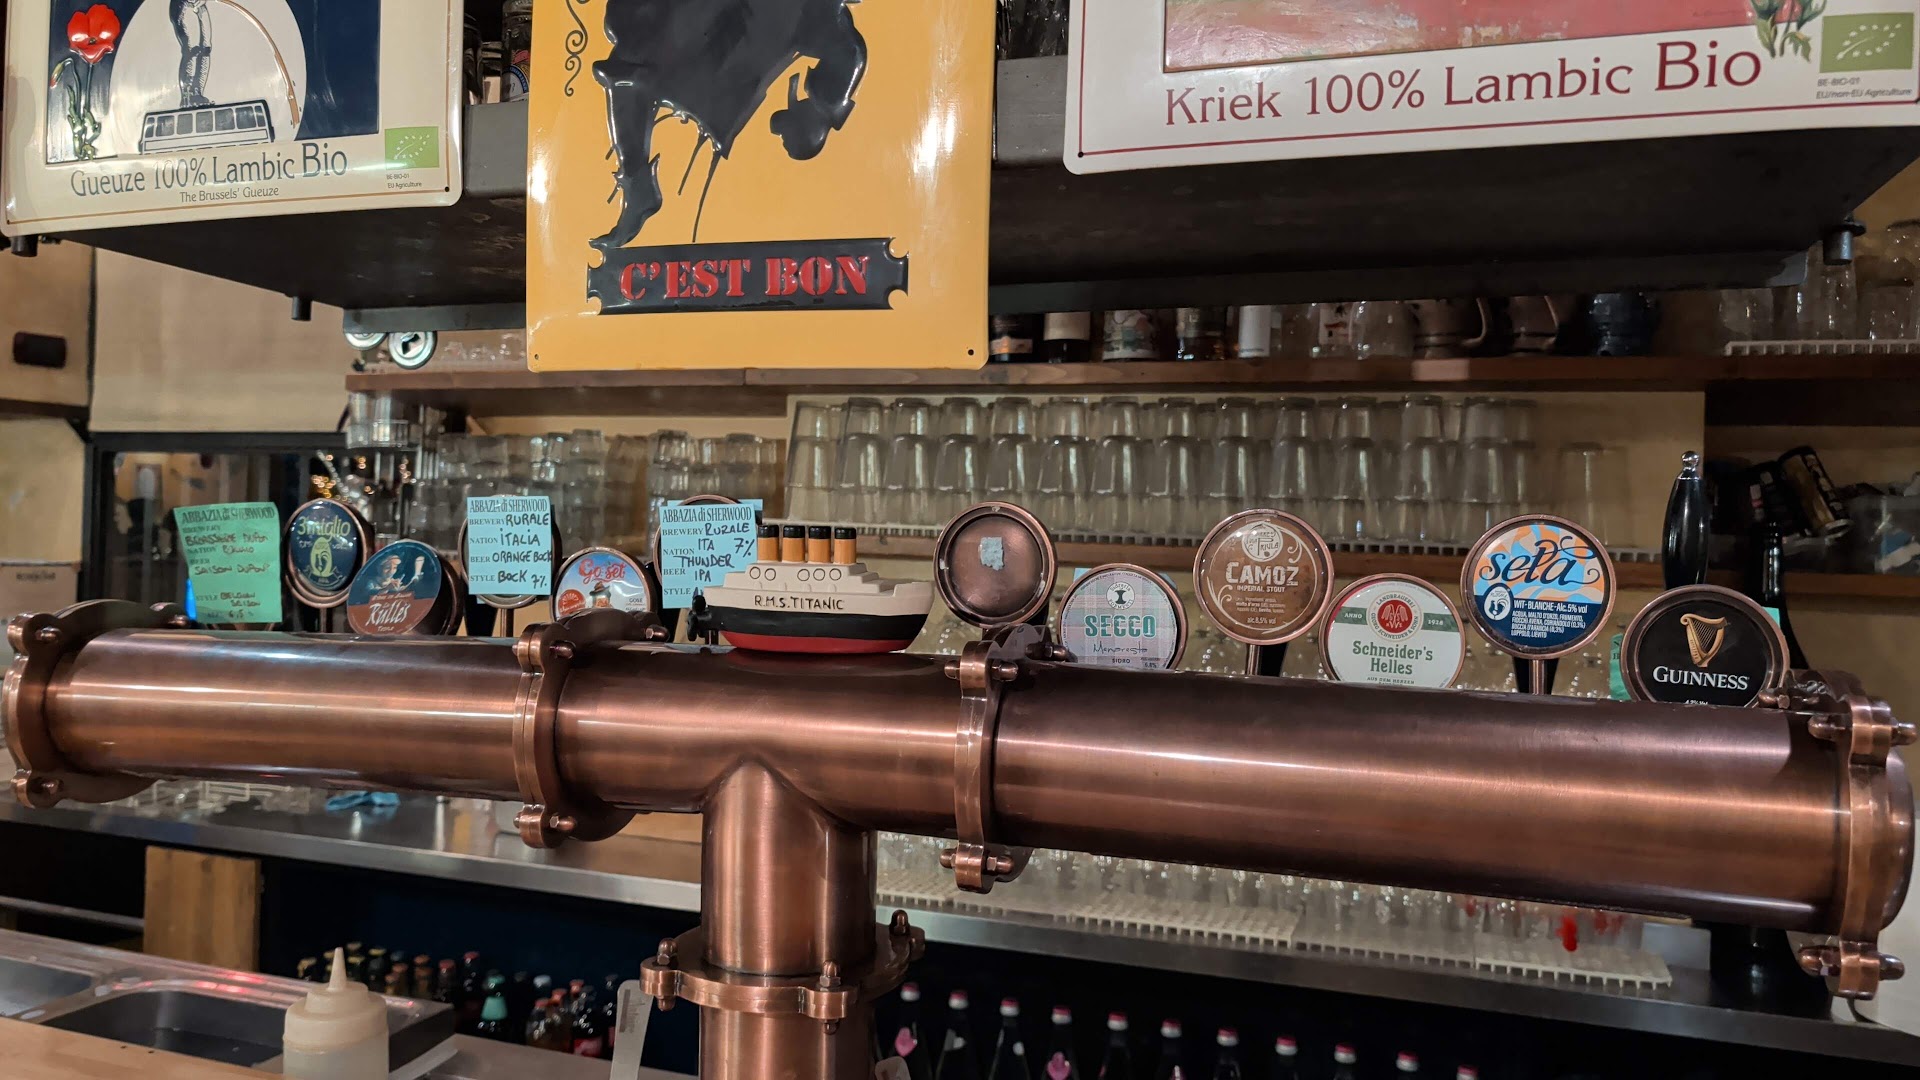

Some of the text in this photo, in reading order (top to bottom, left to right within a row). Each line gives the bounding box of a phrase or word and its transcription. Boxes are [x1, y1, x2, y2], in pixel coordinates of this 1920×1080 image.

[1166, 40, 1762, 125] Kriek 100% Lambic Bio
[1865, 88, 1913, 98] Agriculture
[71, 142, 348, 197] Gueuze 100% Lambic Bio
[396, 181, 422, 189] Agriculture
[180, 186, 279, 202] The Brussels' Gueuze
[619, 255, 871, 301] C'EST BON
[470, 499, 547, 513] ABBAZIA di SHERWOOD
[506, 513, 549, 527] RURALE
[663, 507, 752, 522] ABBAZIA di SHERWOOD
[662, 522, 750, 536] BREWERY RURALE
[500, 528, 540, 546] ITALIA
[698, 538, 755, 557] ITA 7%
[492, 550, 532, 563] ORANGE
[673, 554, 735, 568] THUNDER
[498, 569, 528, 583] BOCK
[531, 574, 547, 589] 7%
[694, 569, 711, 582] IPA
[1225, 562, 1299, 586] CAMOZ
[1376, 594, 1416, 608] LANDBRAUEREI
[1578, 605, 1588, 613] vol
[1085, 615, 1156, 638] SECCO
[1378, 629, 1408, 639] SCHNEIDER
[1352, 640, 1433, 661] Schneider's
[1370, 658, 1413, 675] Helles
[1653, 665, 1748, 690] GUINNESS
